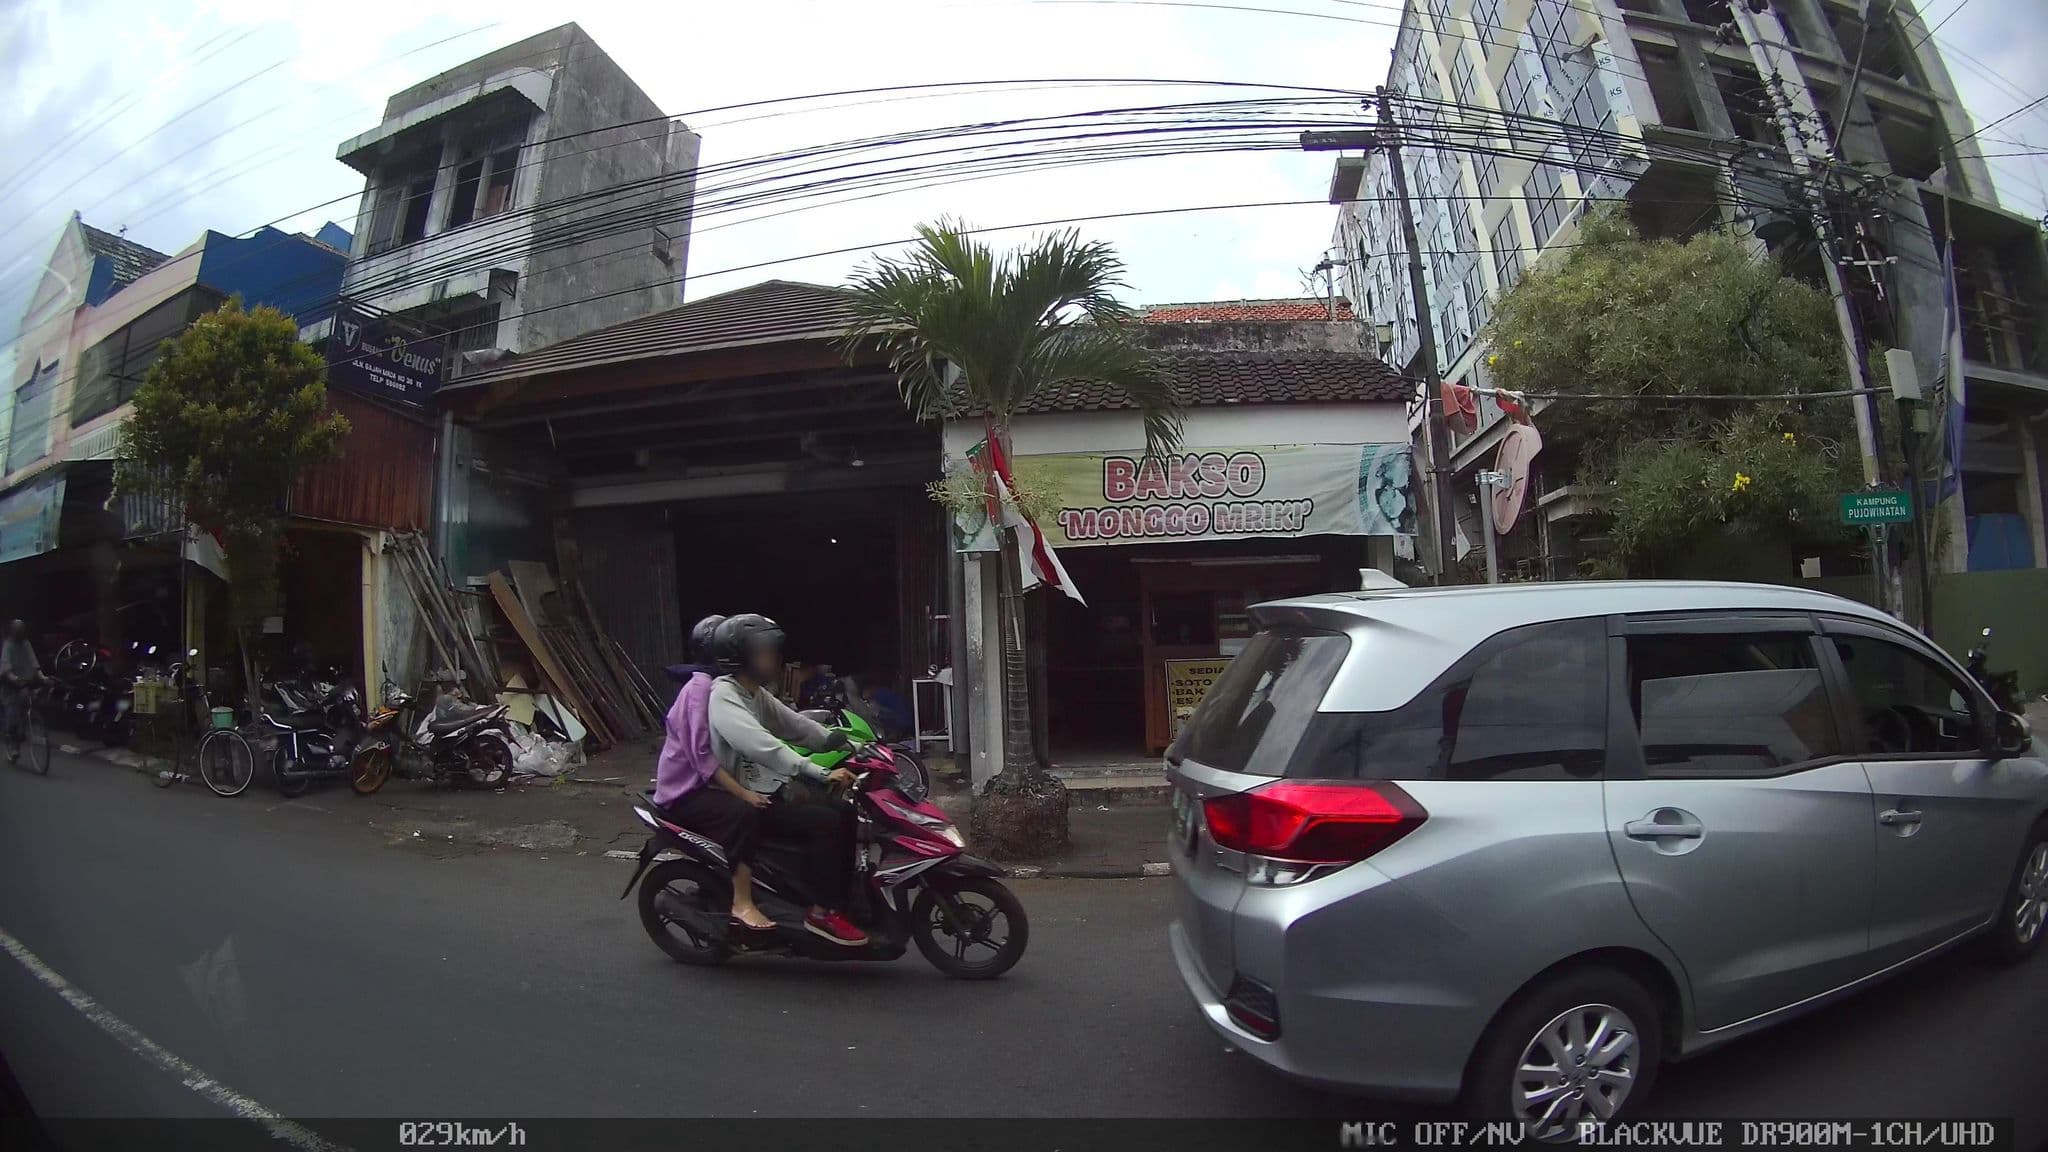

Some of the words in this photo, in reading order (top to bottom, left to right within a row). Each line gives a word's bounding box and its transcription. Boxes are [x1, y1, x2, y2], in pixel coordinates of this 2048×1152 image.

[1104, 453, 1265, 501] BAKSO
[1856, 496, 1897, 506] KAMPUNG
[1848, 506, 1906, 519] PUJOWINATAN
[1175, 688, 1206, 696] BAK
